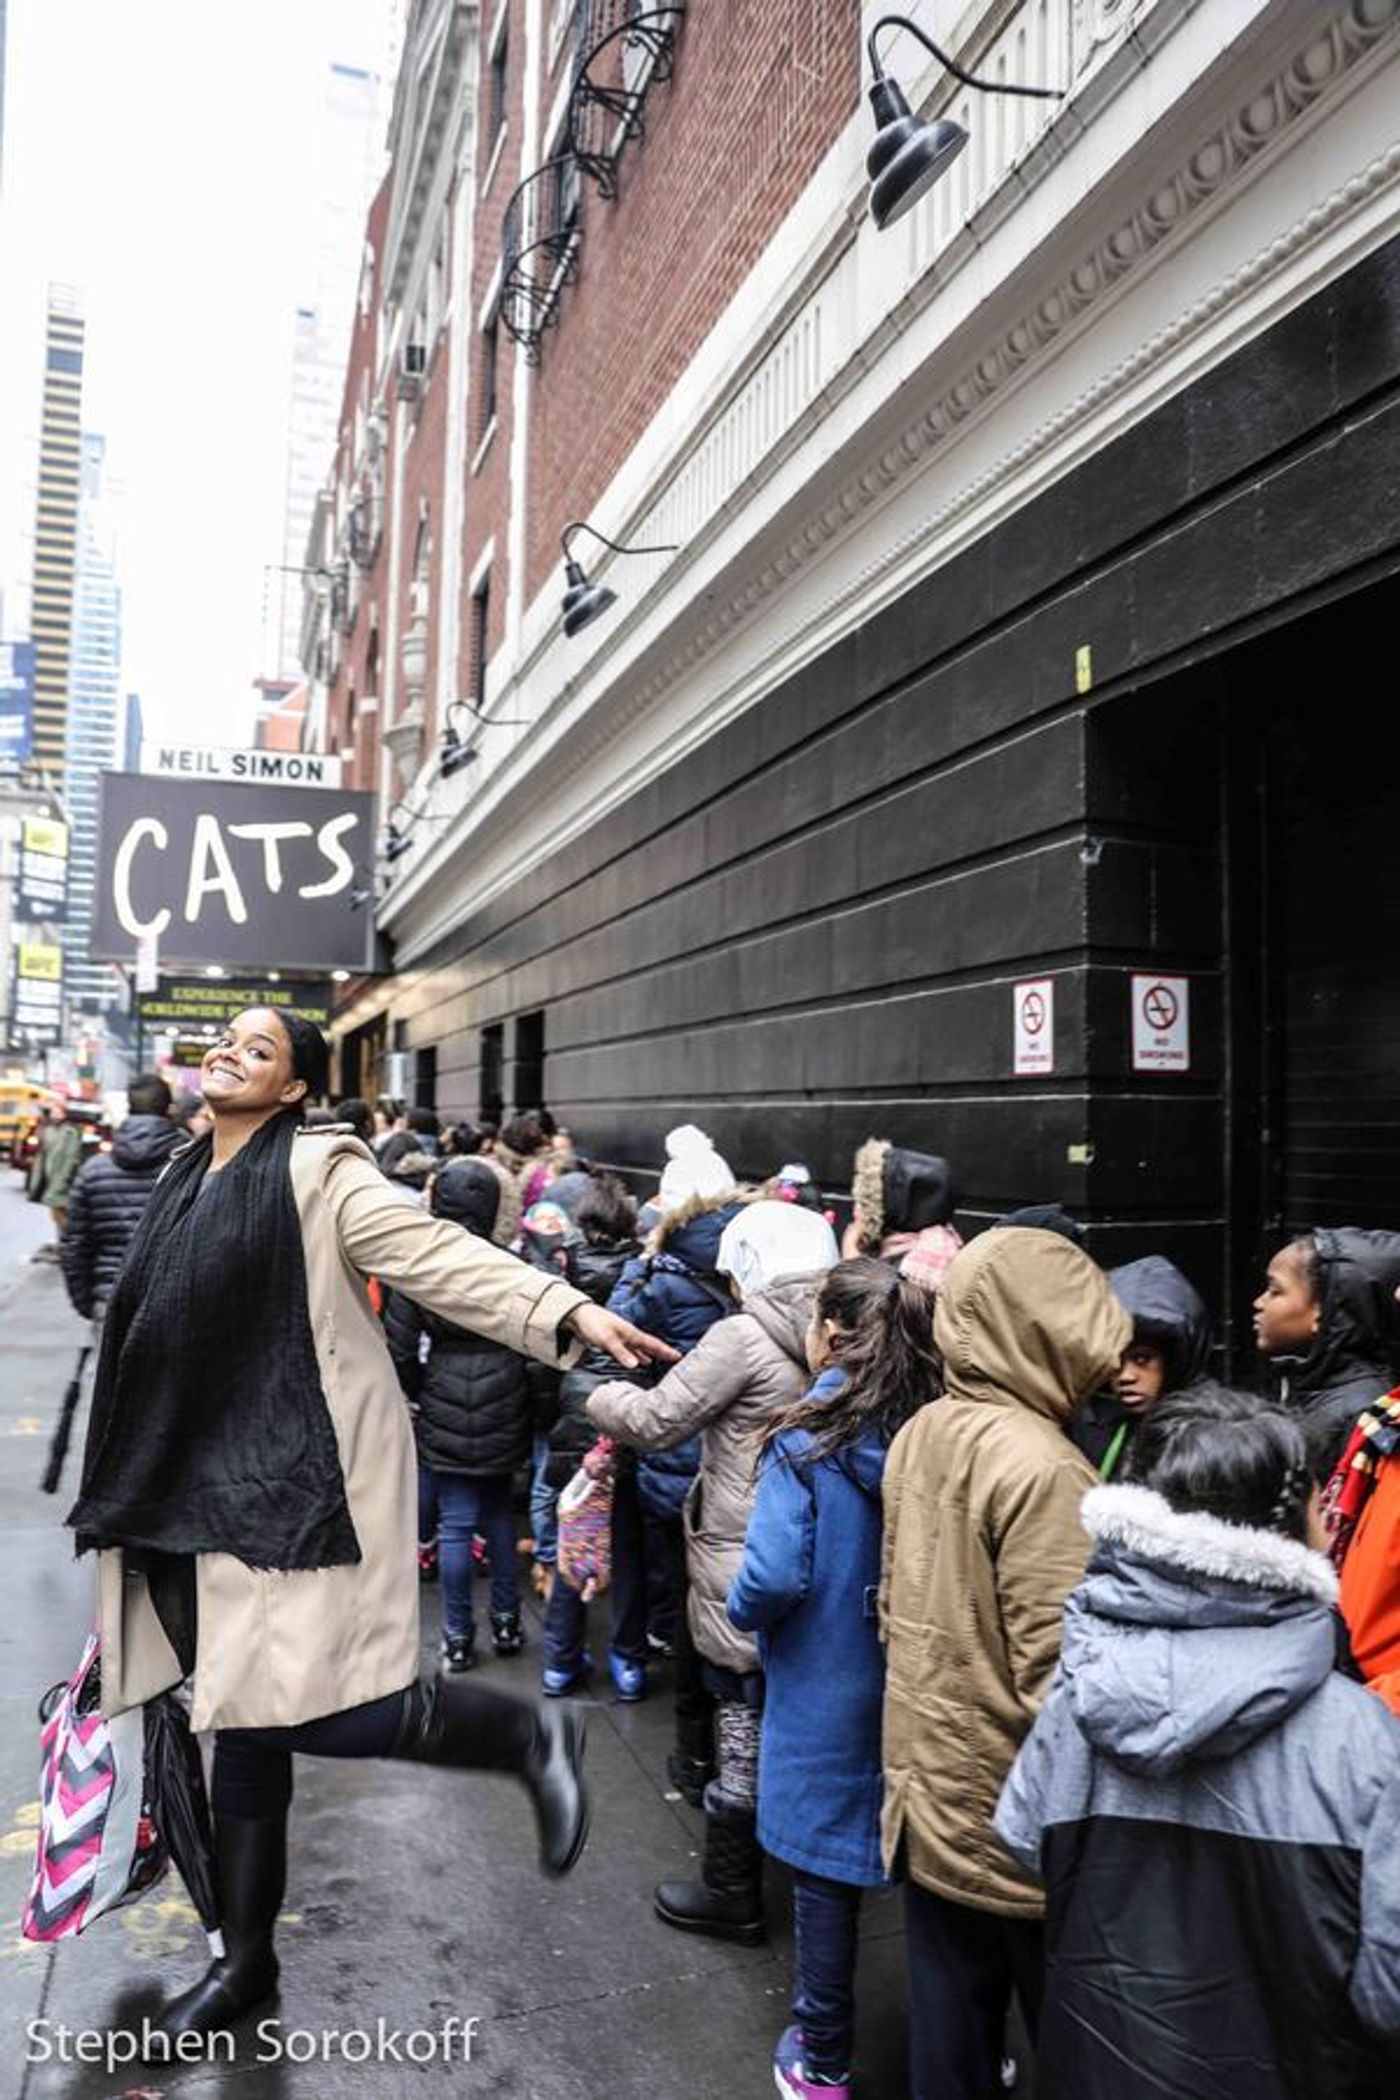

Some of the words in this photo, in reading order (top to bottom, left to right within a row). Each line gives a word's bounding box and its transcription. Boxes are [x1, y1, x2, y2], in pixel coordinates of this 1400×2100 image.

[158, 748, 220, 774] NEIL
[231, 753, 324, 781] SIMON
[113, 812, 359, 938] CATS
[264, 990, 292, 1004] THE
